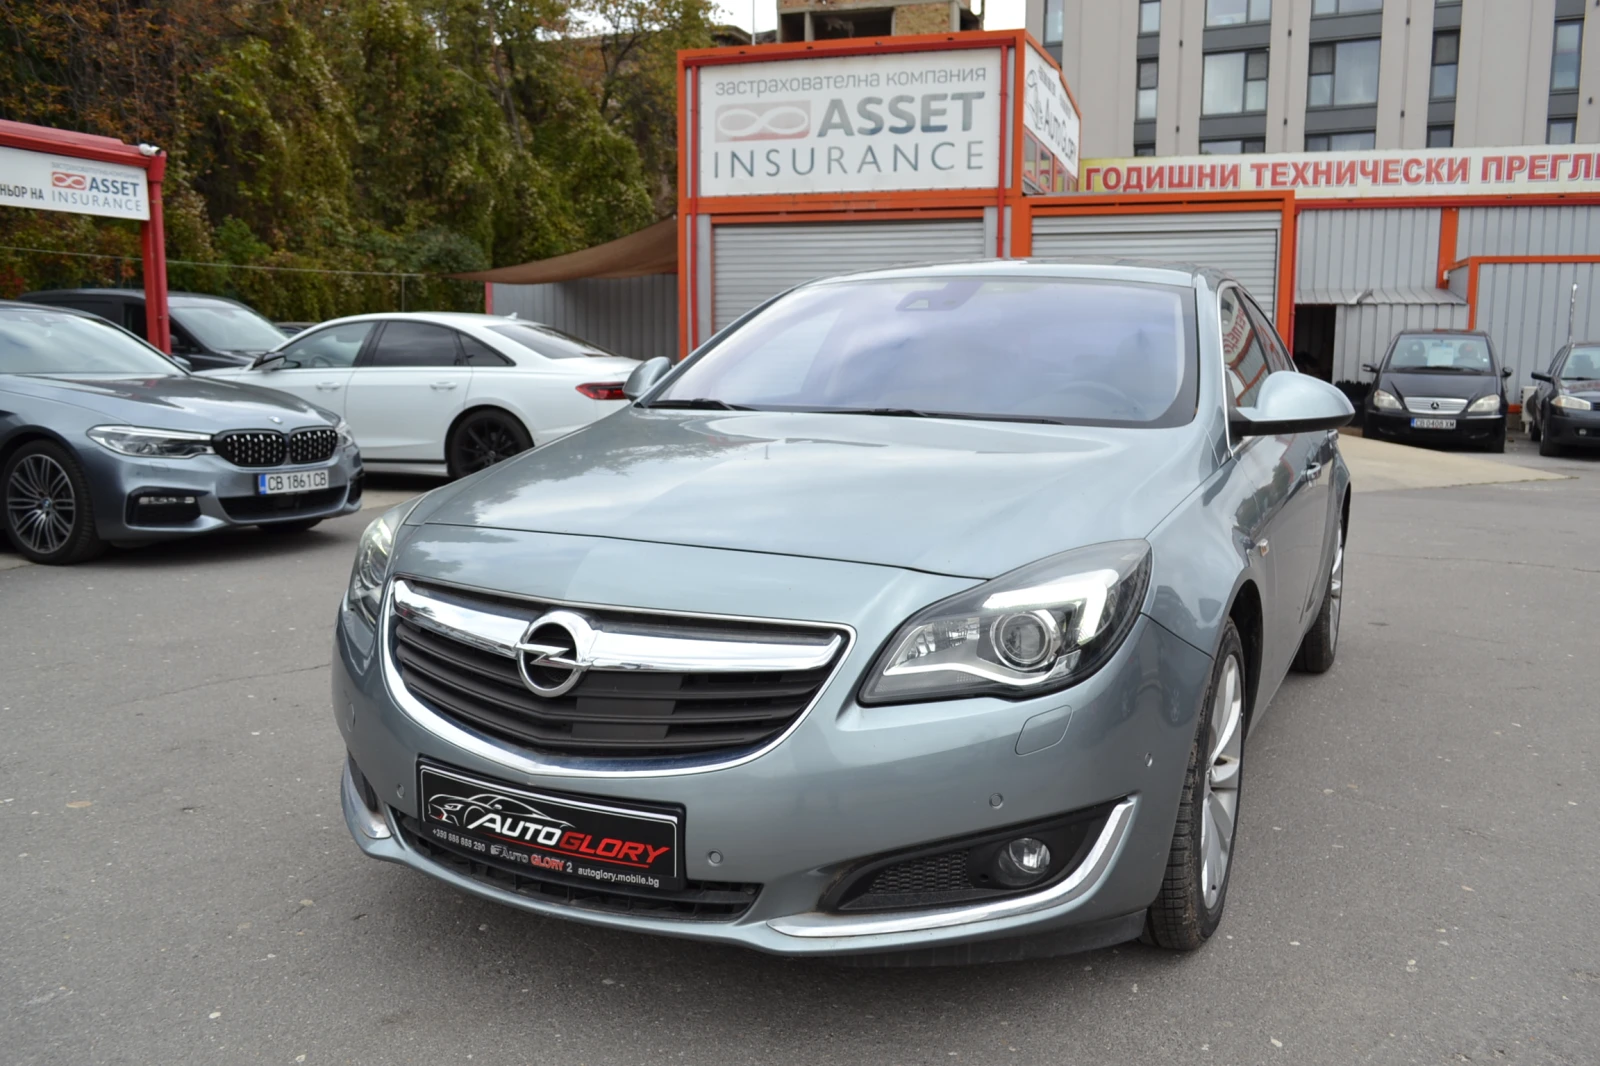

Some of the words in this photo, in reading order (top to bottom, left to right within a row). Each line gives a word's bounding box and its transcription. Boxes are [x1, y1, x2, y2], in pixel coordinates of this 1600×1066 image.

[715, 73, 880, 97] застрахователна
[886, 66, 987, 86] компания
[817, 91, 985, 137] ASSET
[714, 140, 984, 178] INSURANCE
[1085, 163, 1240, 192] ГОДИШНИ
[1251, 156, 1470, 187] ТЕХНИЧЕСКИ
[1481, 152, 1600, 182] ПРЕГЛ
[30, 187, 45, 201] НА
[89, 177, 140, 197] ASSET
[52, 190, 142, 212] INSURANCE
[287, 474, 312, 489] 1861
[500, 846, 529, 863] AUTO
[530, 853, 564, 872] GLORY
[566, 861, 573, 873] 2
[578, 867, 660, 888] autoglory.mobile.bg
